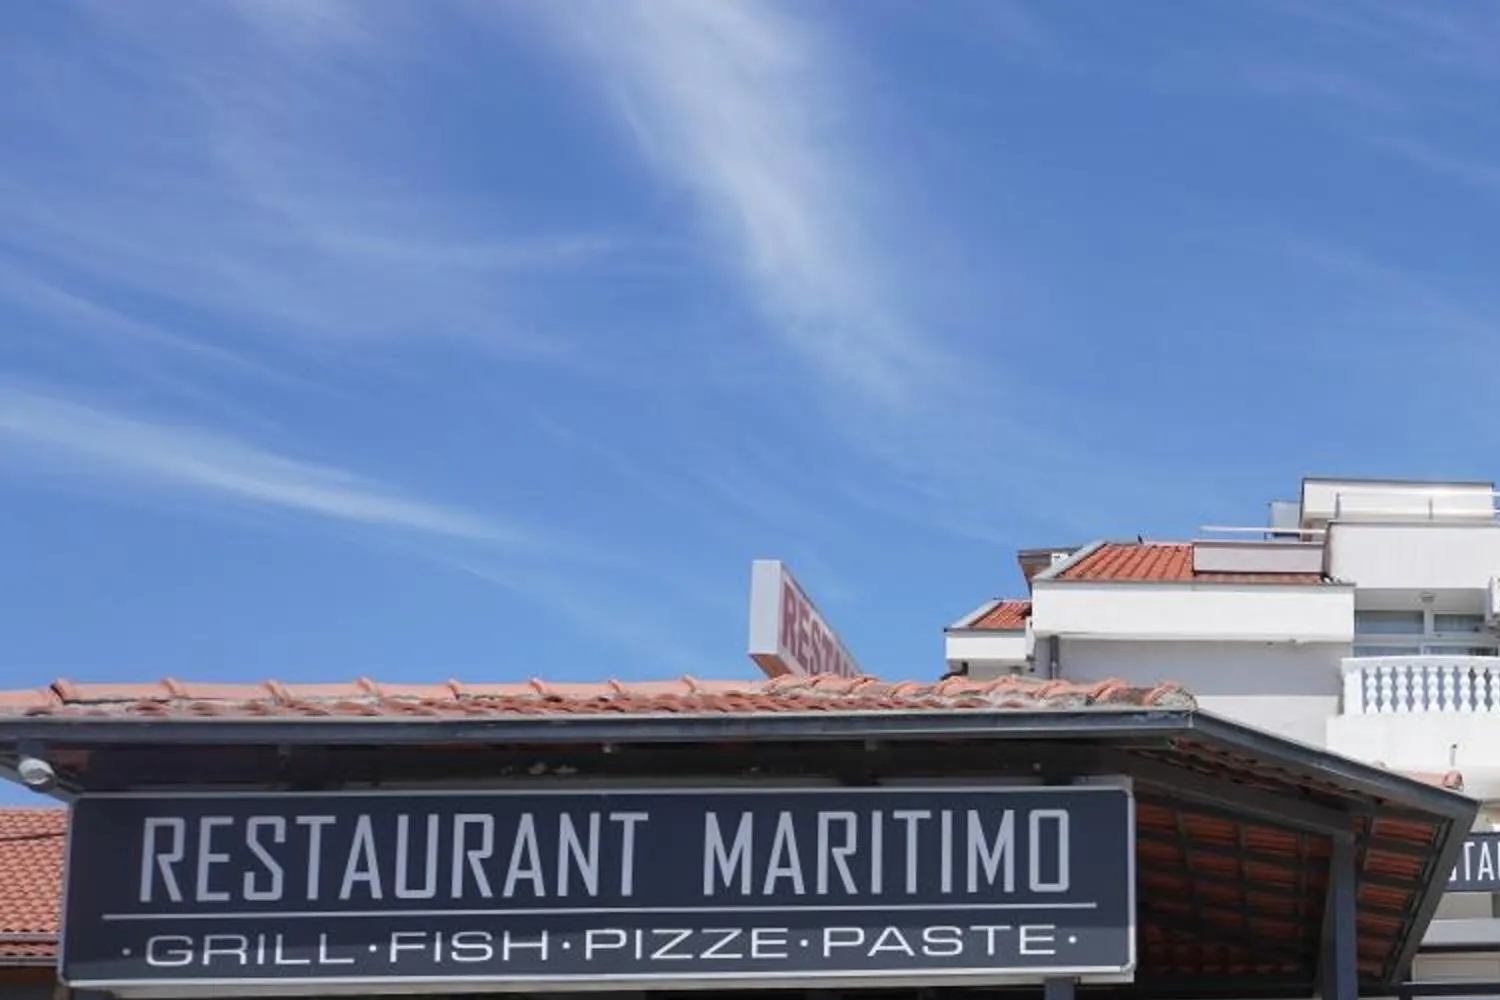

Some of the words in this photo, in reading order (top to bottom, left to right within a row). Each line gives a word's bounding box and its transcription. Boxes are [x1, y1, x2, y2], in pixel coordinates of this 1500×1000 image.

[139, 811, 650, 902] RESTAURANT
[702, 809, 1070, 896] MARITIMO
[146, 933, 355, 966] GRILL
[390, 930, 549, 962] FISH
[586, 928, 789, 960] PIZZE
[823, 925, 1057, 957] PASTE
